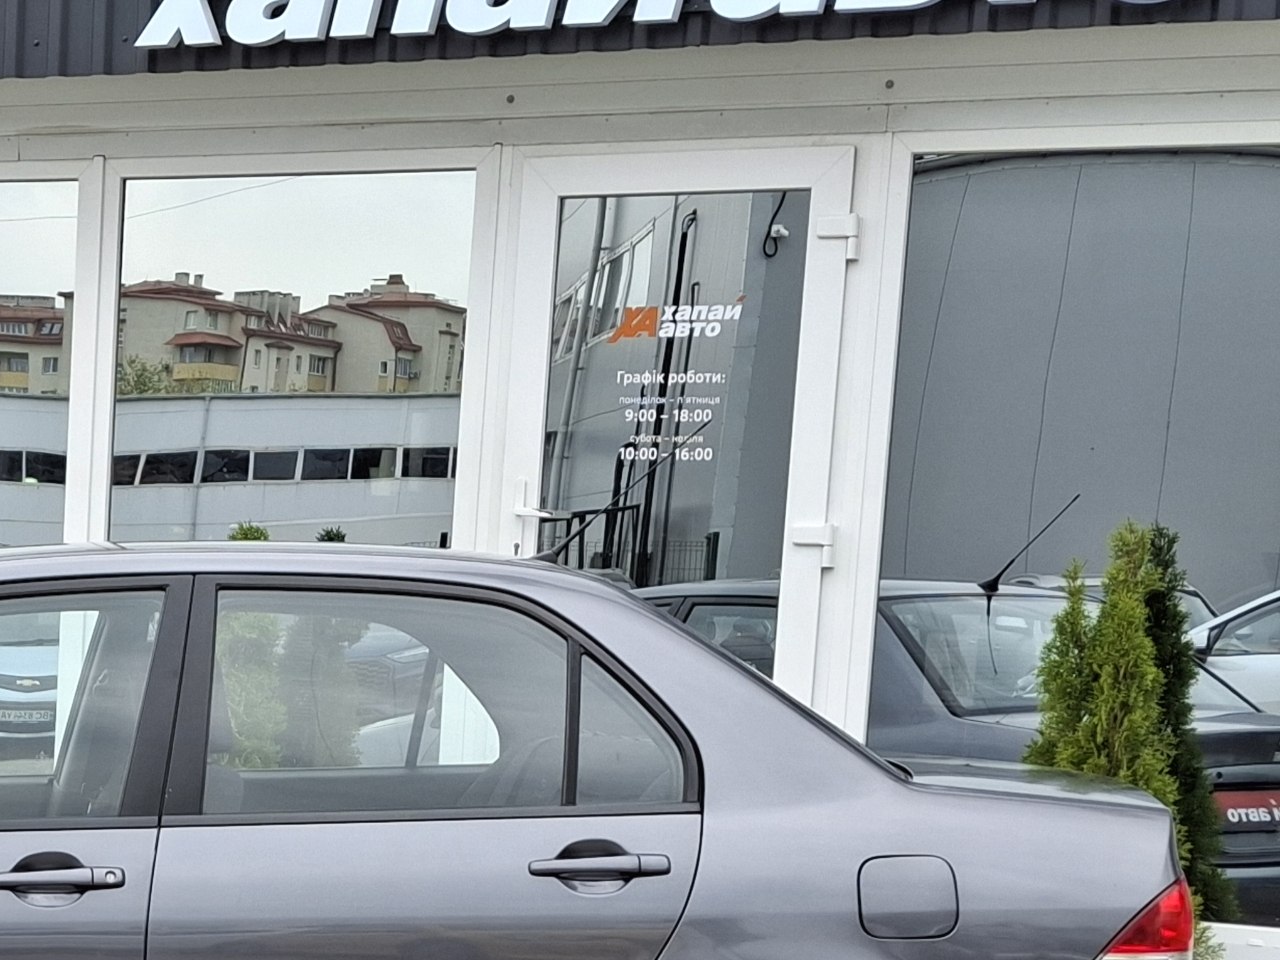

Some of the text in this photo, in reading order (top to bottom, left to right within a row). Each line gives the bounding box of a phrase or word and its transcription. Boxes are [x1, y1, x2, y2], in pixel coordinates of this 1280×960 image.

[658, 321, 721, 338] авто
[616, 370, 726, 387] Графік роботи:
[625, 409, 656, 422] 9:00
[673, 409, 712, 422] 18:00
[618, 447, 658, 460] 10:00
[675, 447, 713, 460] 16:00
